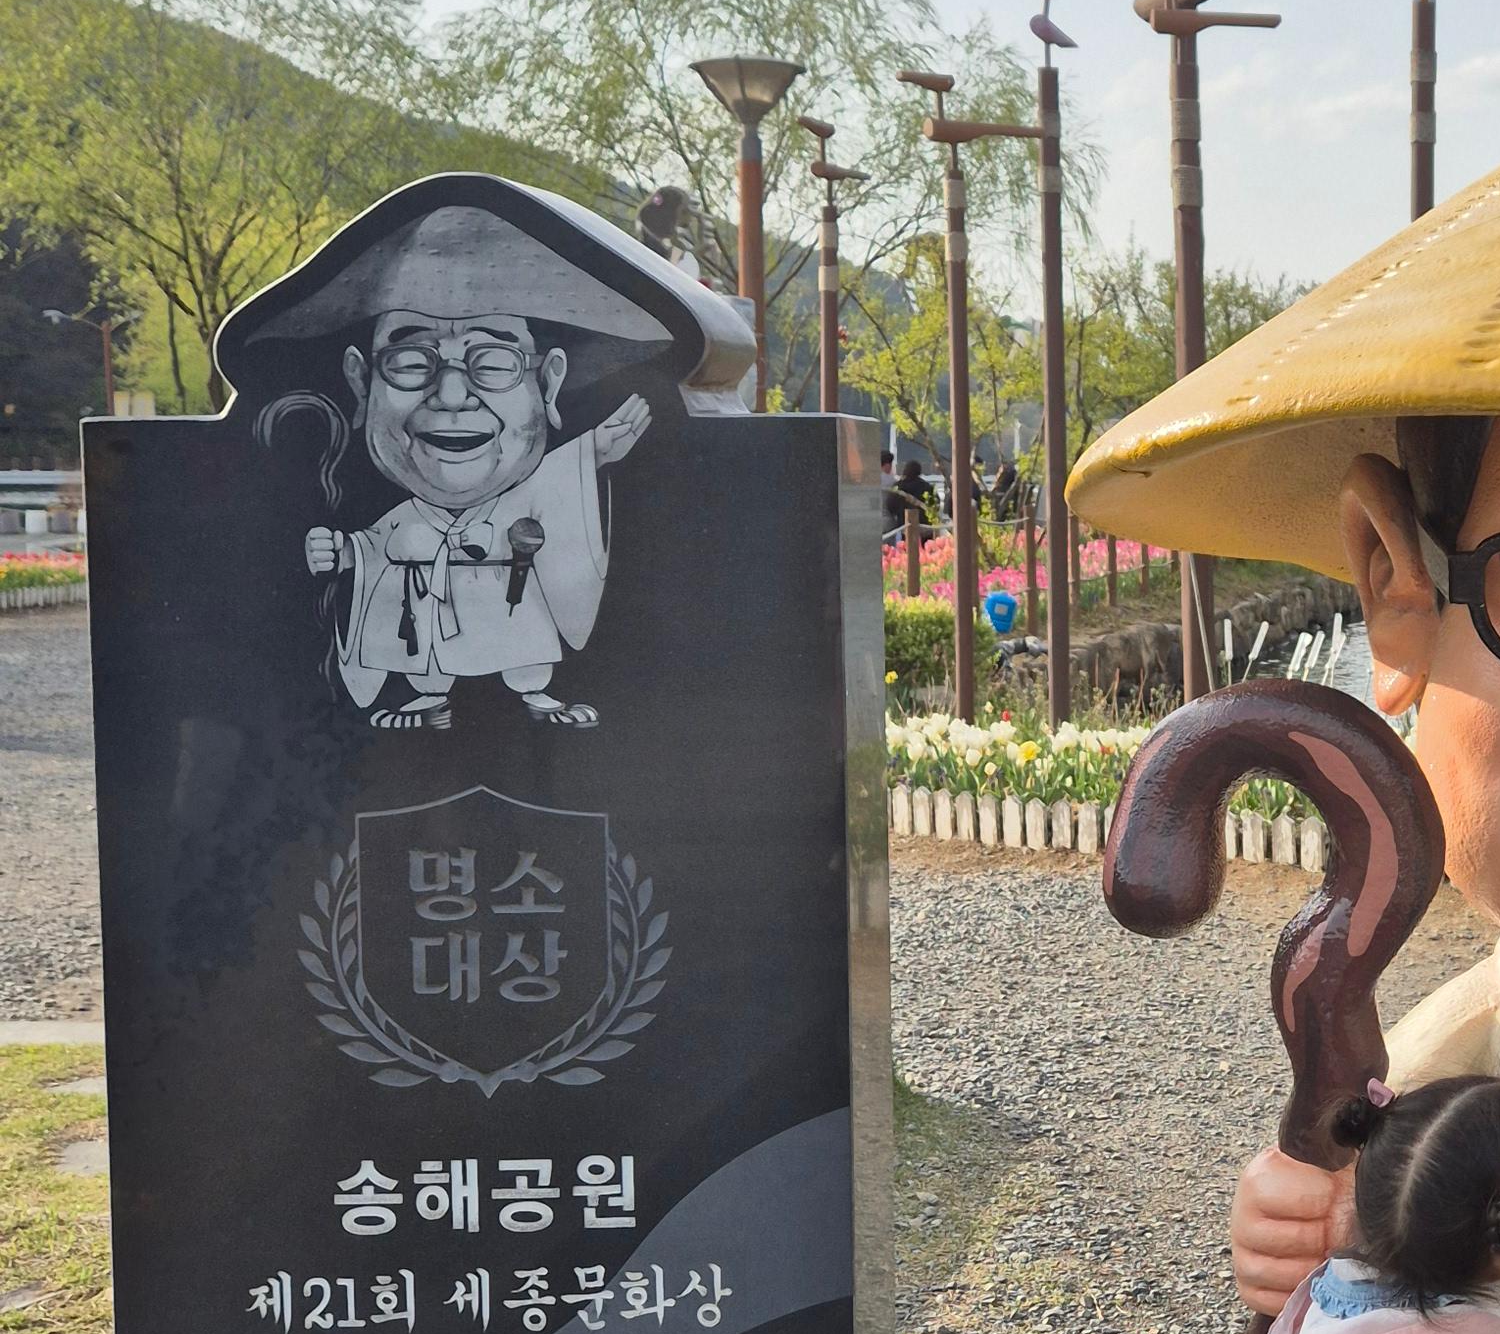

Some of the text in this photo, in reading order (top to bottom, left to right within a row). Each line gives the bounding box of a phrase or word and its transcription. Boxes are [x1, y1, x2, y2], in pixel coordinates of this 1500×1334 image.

[408, 846, 567, 921] 명소
[409, 929, 568, 1003] 대상
[334, 1154, 636, 1235] 송해공원
[246, 1263, 733, 1334] 제21회 세종문화상
